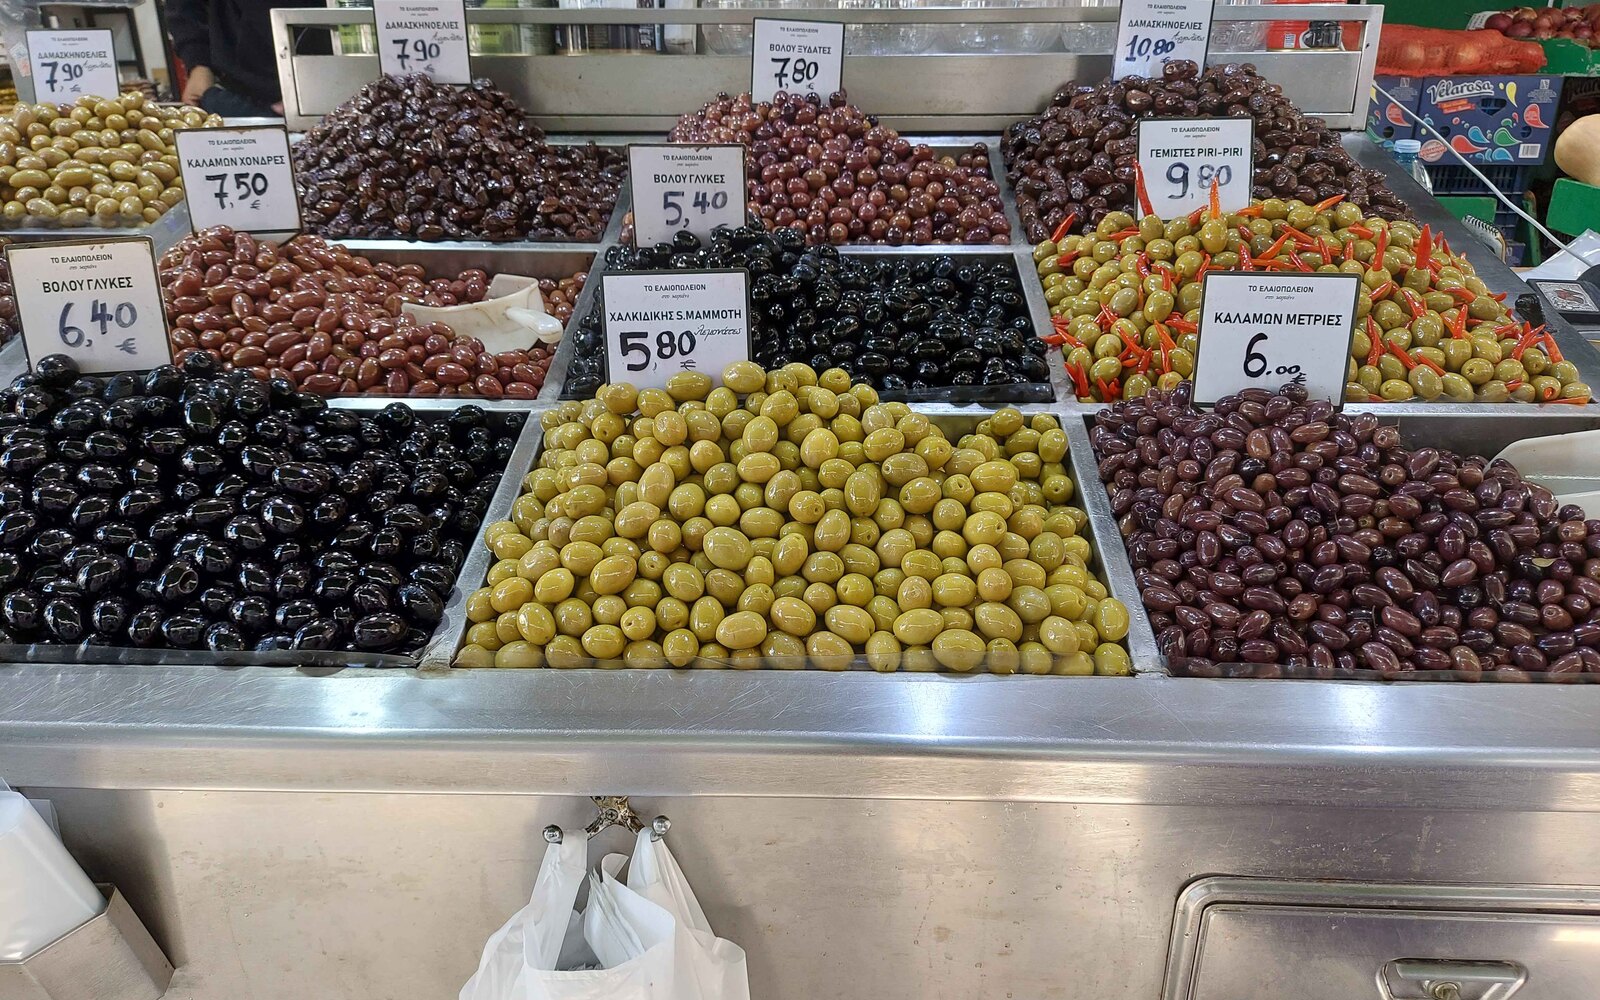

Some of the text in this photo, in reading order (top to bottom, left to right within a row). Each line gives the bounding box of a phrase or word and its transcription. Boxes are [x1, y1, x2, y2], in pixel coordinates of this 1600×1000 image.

[1128, 20, 1203, 30] ΔΑΜΑΣΚΗΝΟΕΛΙΕΣ
[38, 51, 107, 59] ΔΑΜΑΣΚΗΝΟΕΛΙΕΣ
[392, 38, 440, 71] 7,90
[770, 44, 832, 54] ΒΟΛΟΥ ΞΥΔΑΤΕΣ
[1125, 35, 1175, 62] 10,80
[41, 61, 83, 92] 7,90
[771, 58, 819, 89] 7,80
[1150, 148, 1243, 158] ΓΕΜΙΣΤΕΣ PIRI-PIRI
[187, 156, 285, 168] ΚΑΛΑΜΩΝ ΧΟΝΔΡΕΣ
[654, 174, 725, 184] ΒΟΛΟΥ ΓΛΥΚΕΣ
[1166, 162, 1232, 199] 9,80
[205, 172, 268, 210] 7,50 €
[663, 190, 728, 228] 5,40
[62, 254, 112, 263] ΕΛΑΙΟΠΩΛΕΙΟΝ
[42, 277, 133, 293] ΒΟΛΟΥ ΓΛΥΚΕΣ
[610, 311, 674, 322] ΧΑΛΚΙΔΙΚΗΣ
[1214, 312, 1343, 326] ΚΑΛΑΜΩΝ ΜΕΤΡΙΕΣ
[58, 299, 138, 355] 6,40 €
[620, 330, 697, 372] 5,80 €
